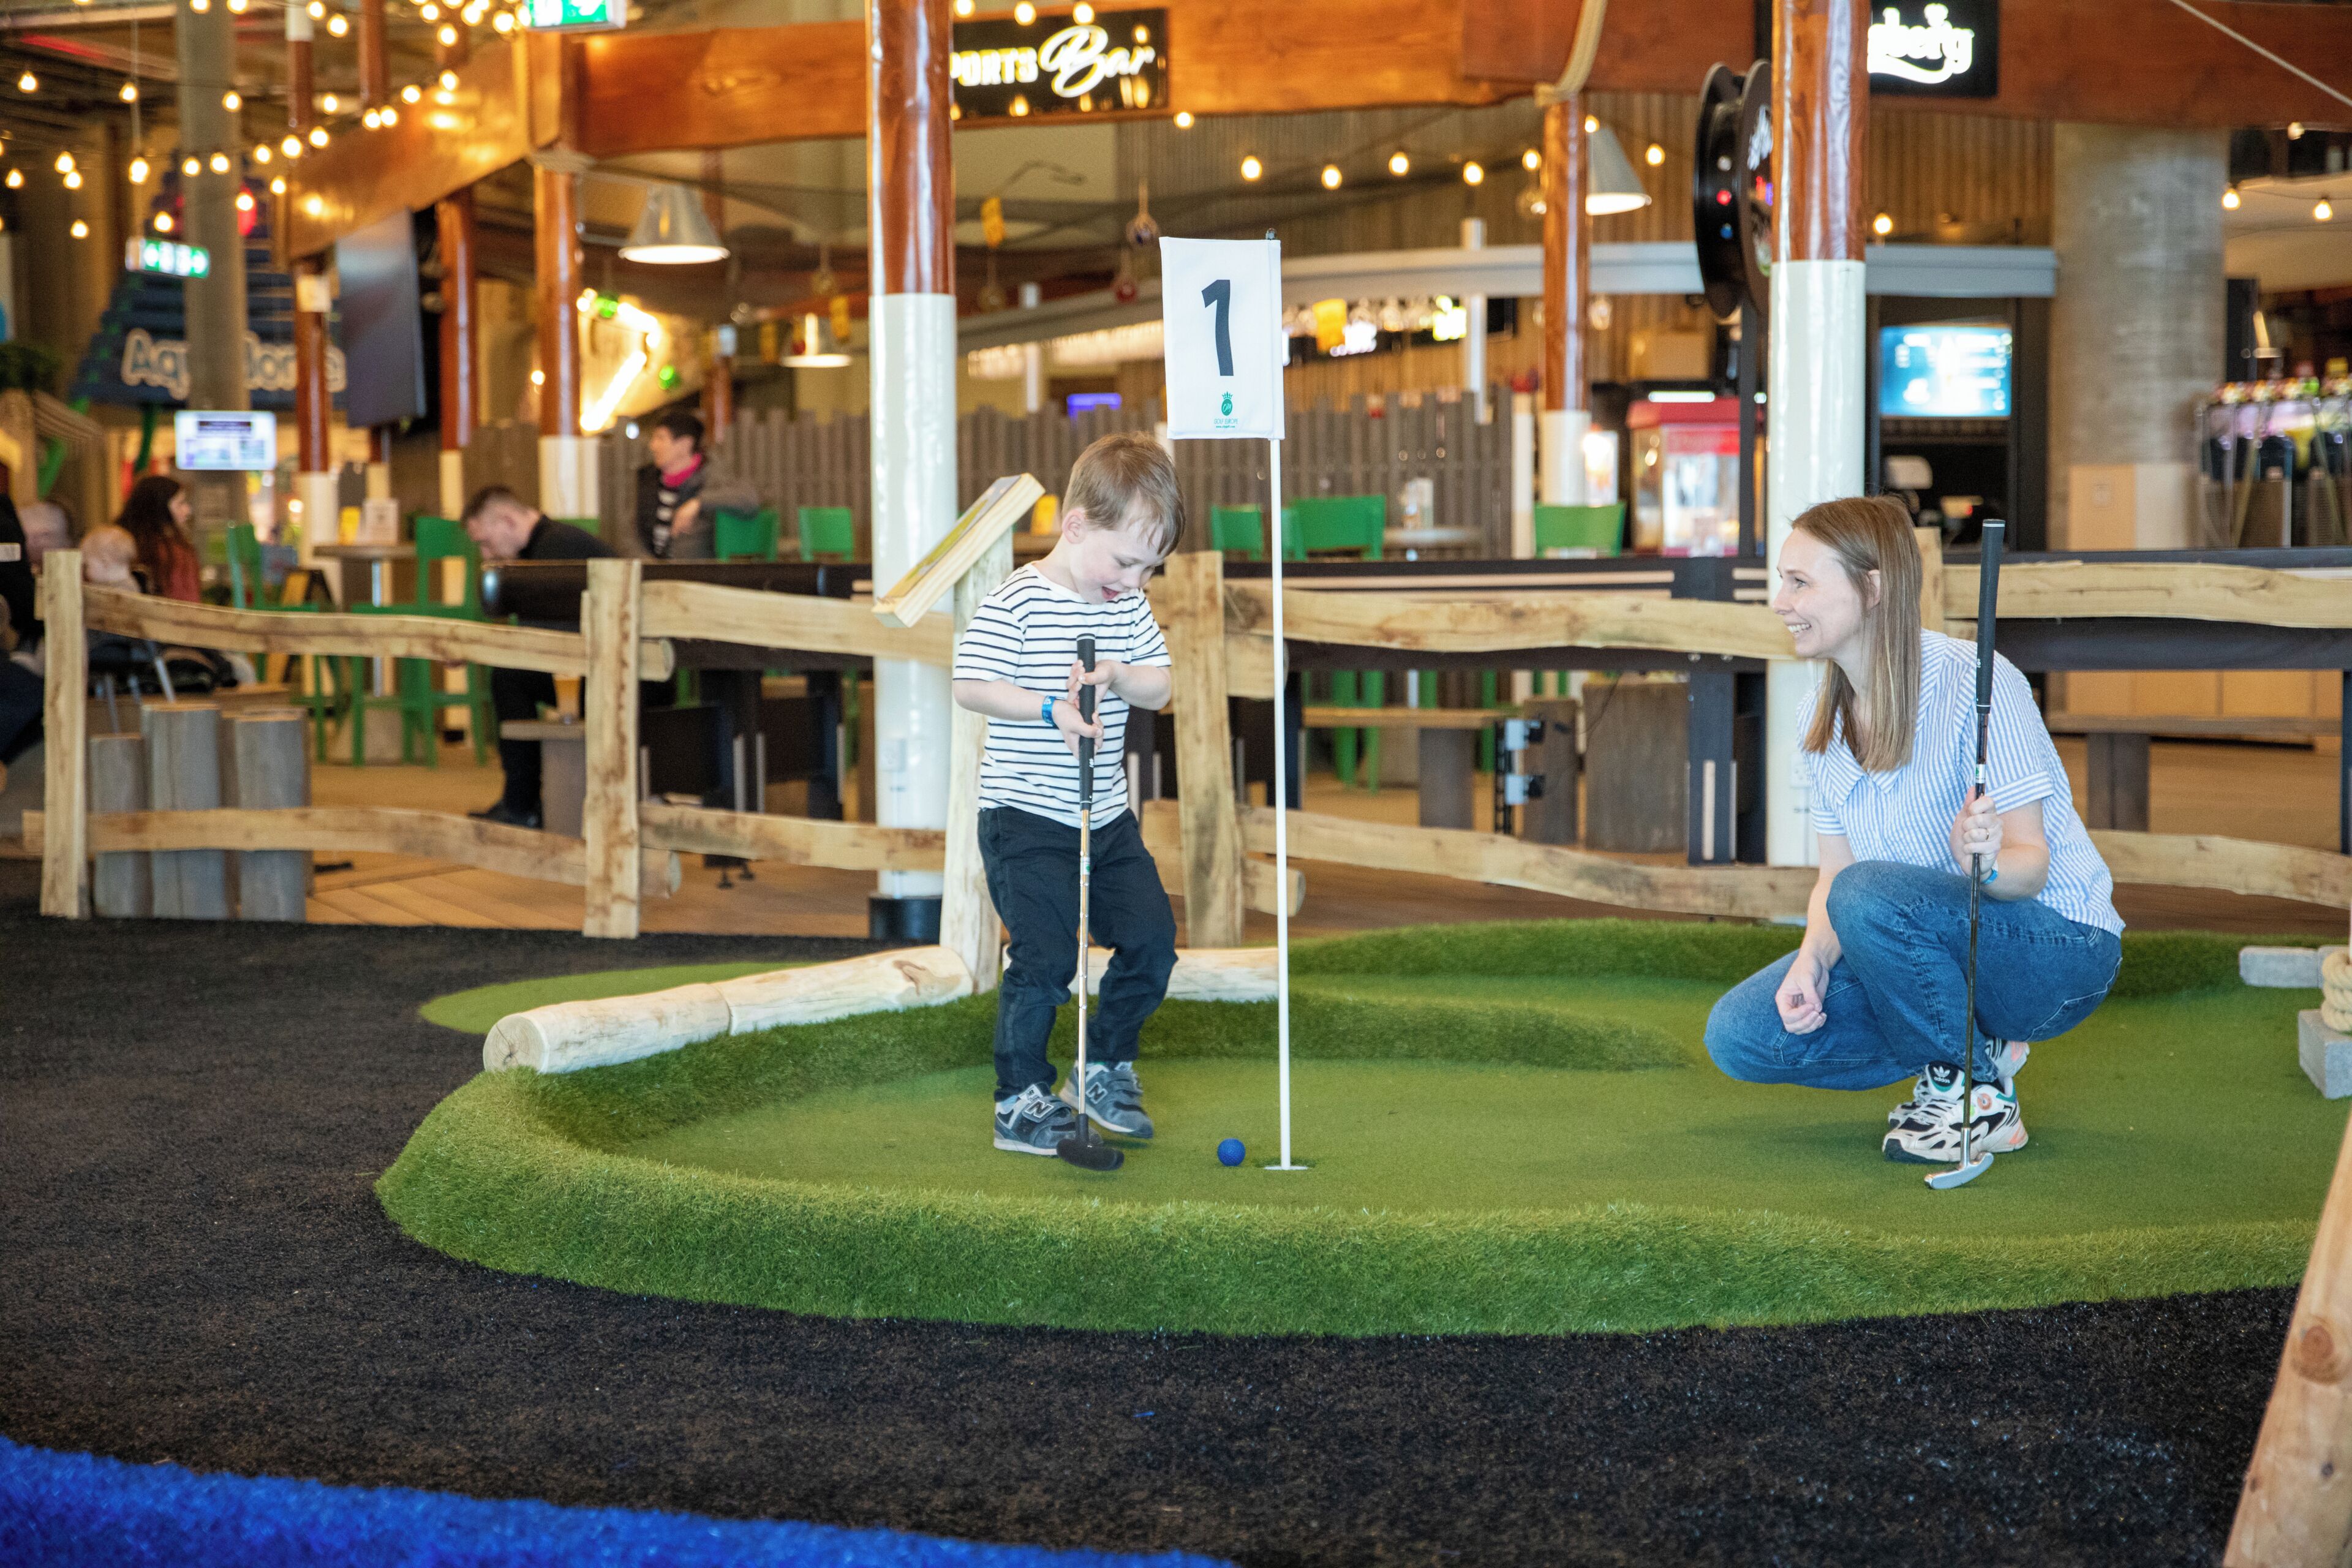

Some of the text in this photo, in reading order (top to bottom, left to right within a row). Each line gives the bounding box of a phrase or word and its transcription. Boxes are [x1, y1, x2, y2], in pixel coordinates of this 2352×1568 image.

[1037, 24, 1156, 97] Bar
[1201, 279, 1234, 376] 1
[1025, 1099, 1054, 1118] N
[1086, 1082, 1108, 1104] N
